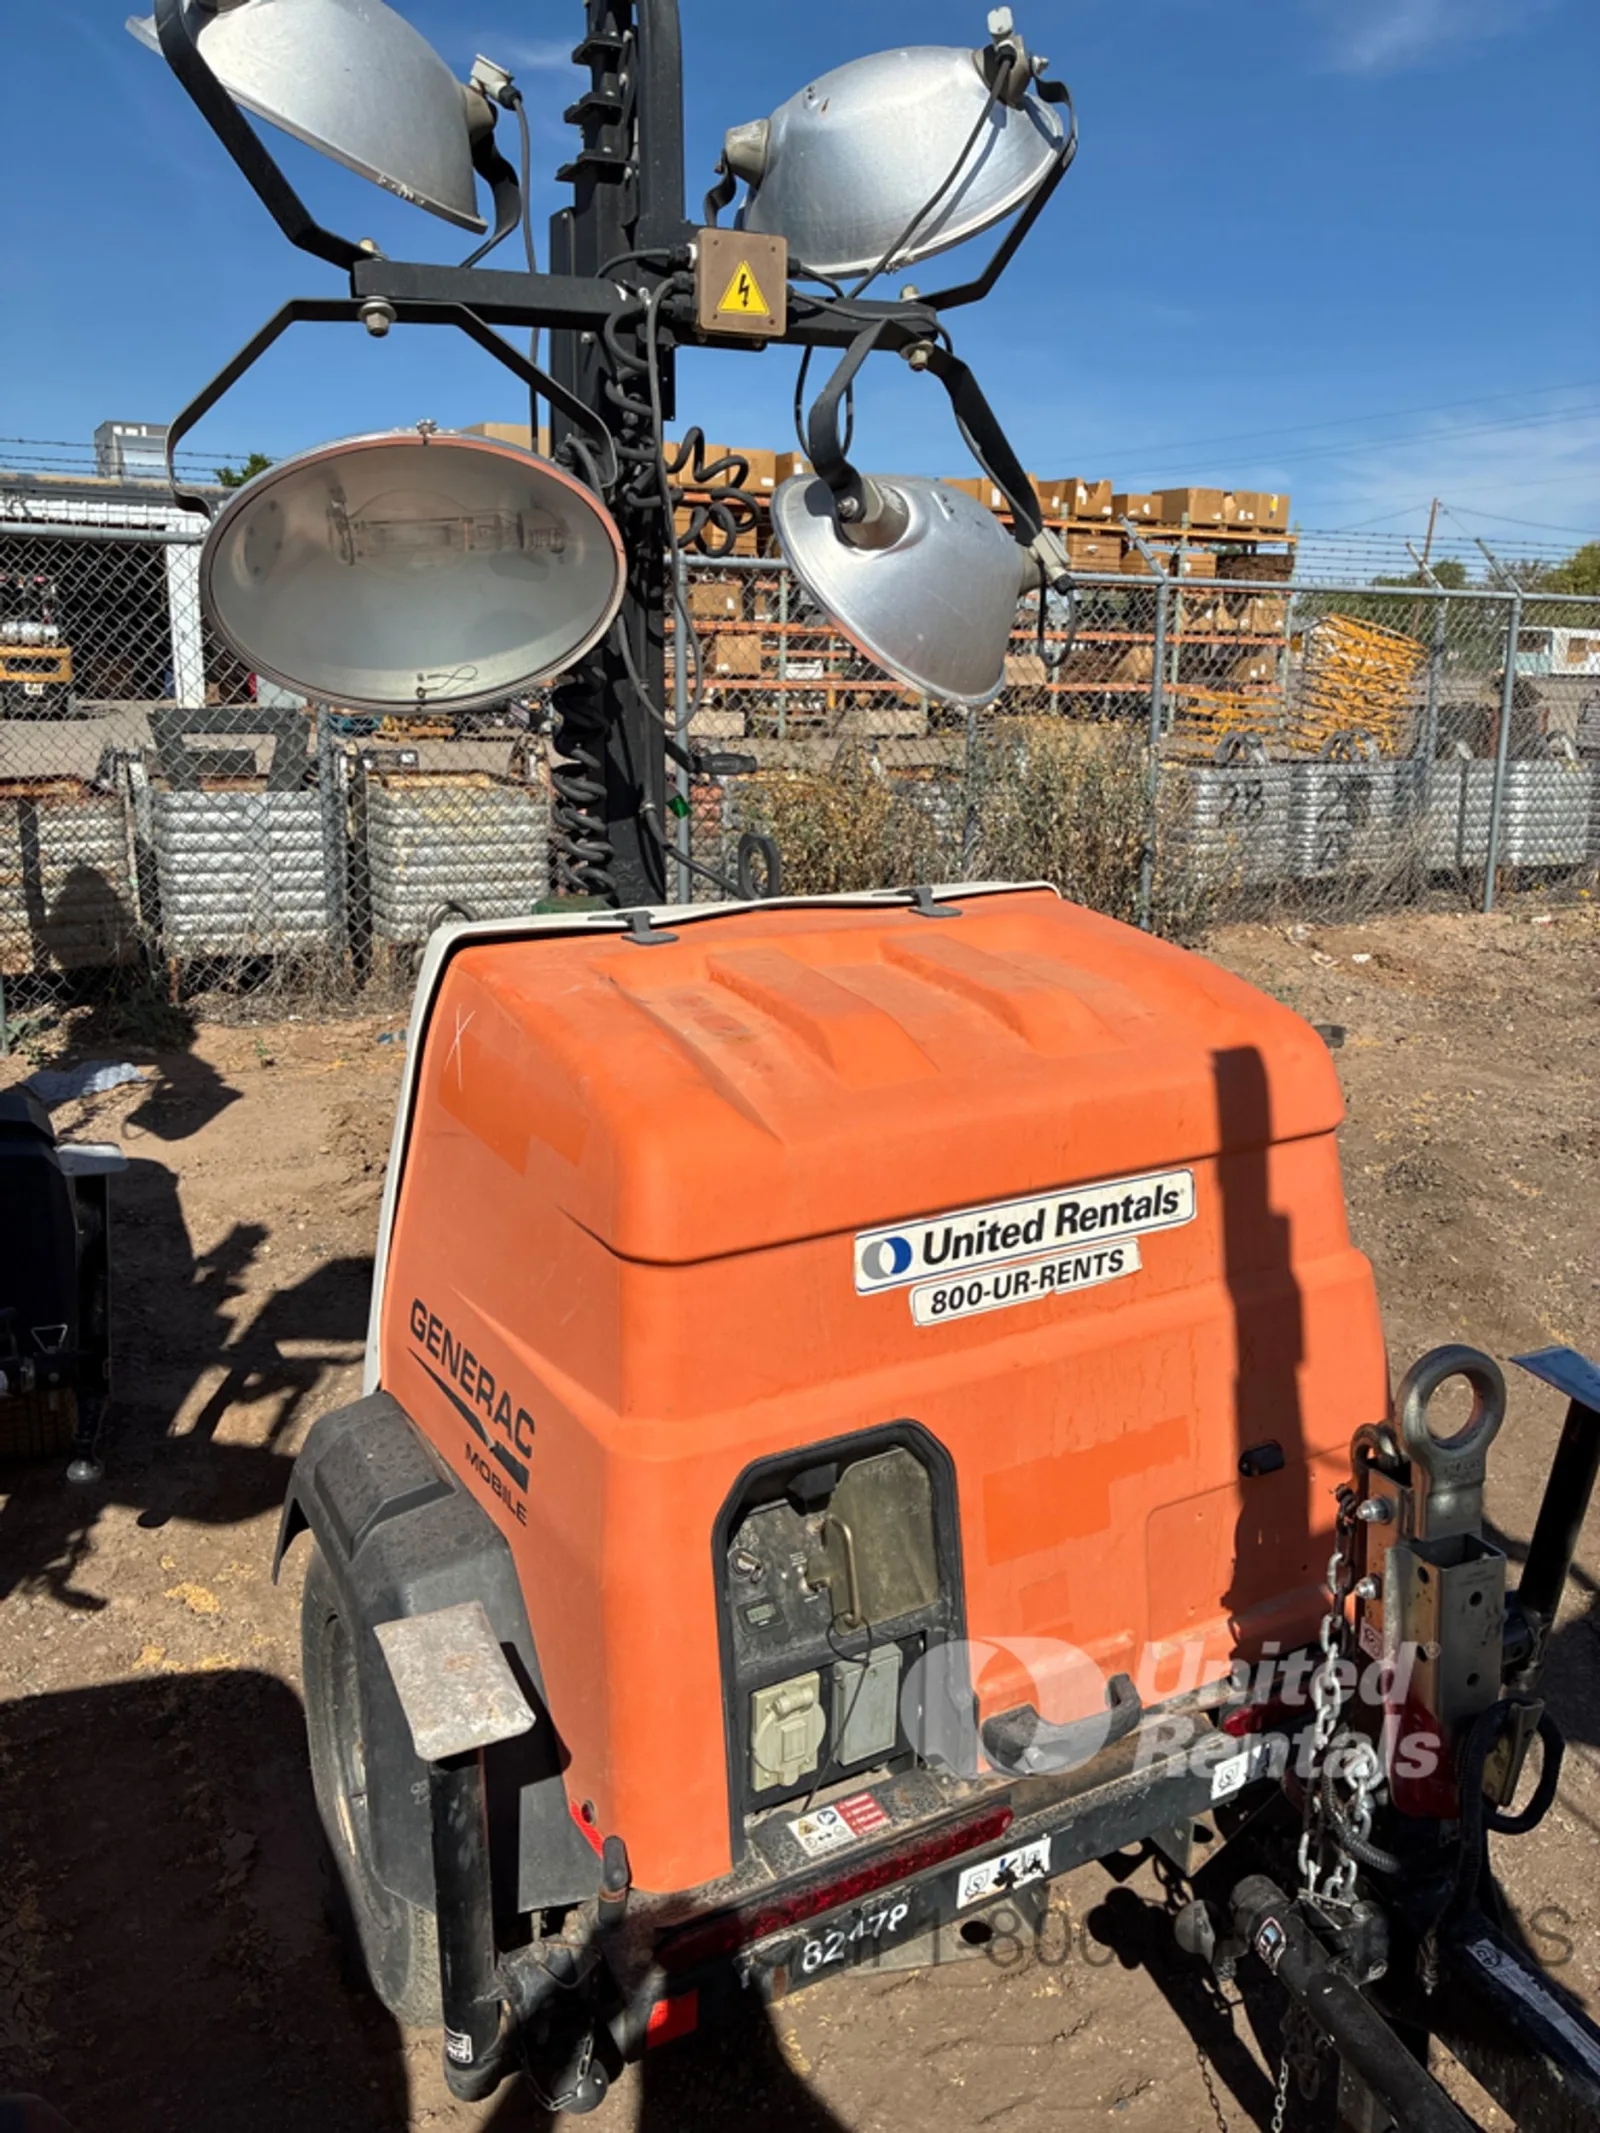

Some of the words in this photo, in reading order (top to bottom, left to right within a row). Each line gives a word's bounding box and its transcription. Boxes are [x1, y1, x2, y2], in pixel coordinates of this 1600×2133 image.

[923, 1209, 1046, 1265] United
[1056, 1185, 1180, 1237] Rentals
[930, 1248, 1124, 1315] 800-UR-RENTS
[410, 1298, 535, 1460] GENERAC
[464, 1441, 527, 1527] MOBILE
